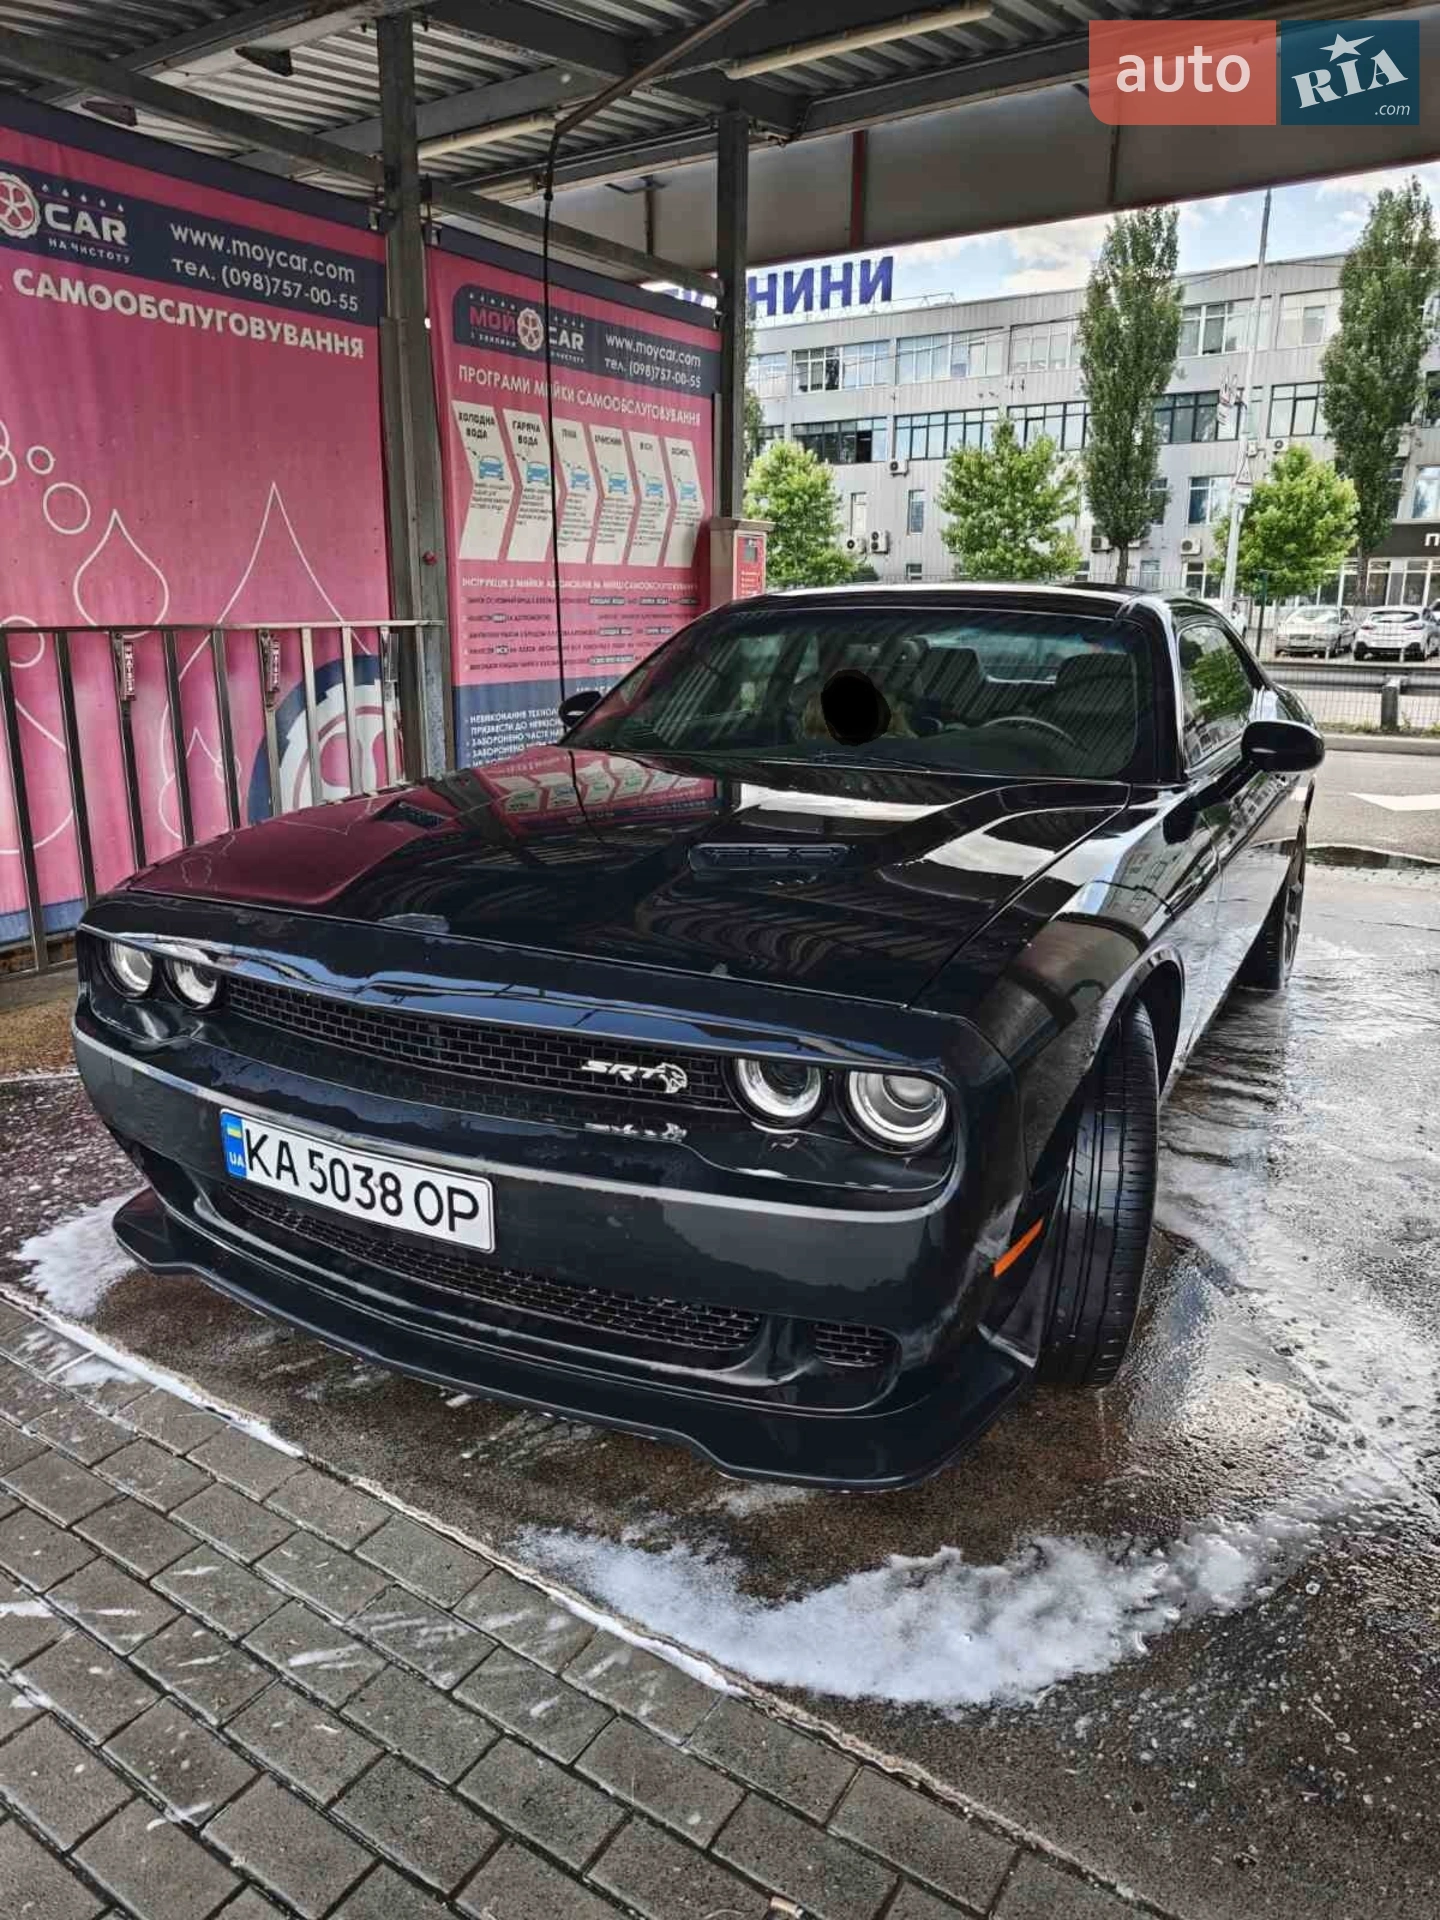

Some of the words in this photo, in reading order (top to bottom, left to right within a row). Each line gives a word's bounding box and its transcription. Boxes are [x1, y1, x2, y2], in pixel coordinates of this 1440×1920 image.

[45, 203, 128, 246] CAR
[169, 223, 356, 283] www.moycar.com
[171, 258, 216, 281] тел.
[221, 265, 359, 312] (098)757-00-55
[13, 268, 364, 359] САМООБСЛУГОВУВАННЯ
[605, 333, 701, 367] www.moycar.com
[459, 364, 530, 394] ПРОГРАМИ
[466, 427, 488, 439] ВОДА
[512, 420, 541, 433] ГАРЯЧА
[518, 434, 539, 446] ВОДА
[581, 1060, 663, 1081] SRT
[229, 1151, 245, 1168] UA
[245, 1128, 300, 1187] KA
[307, 1148, 403, 1217] 5038
[414, 1180, 480, 1232] OP
